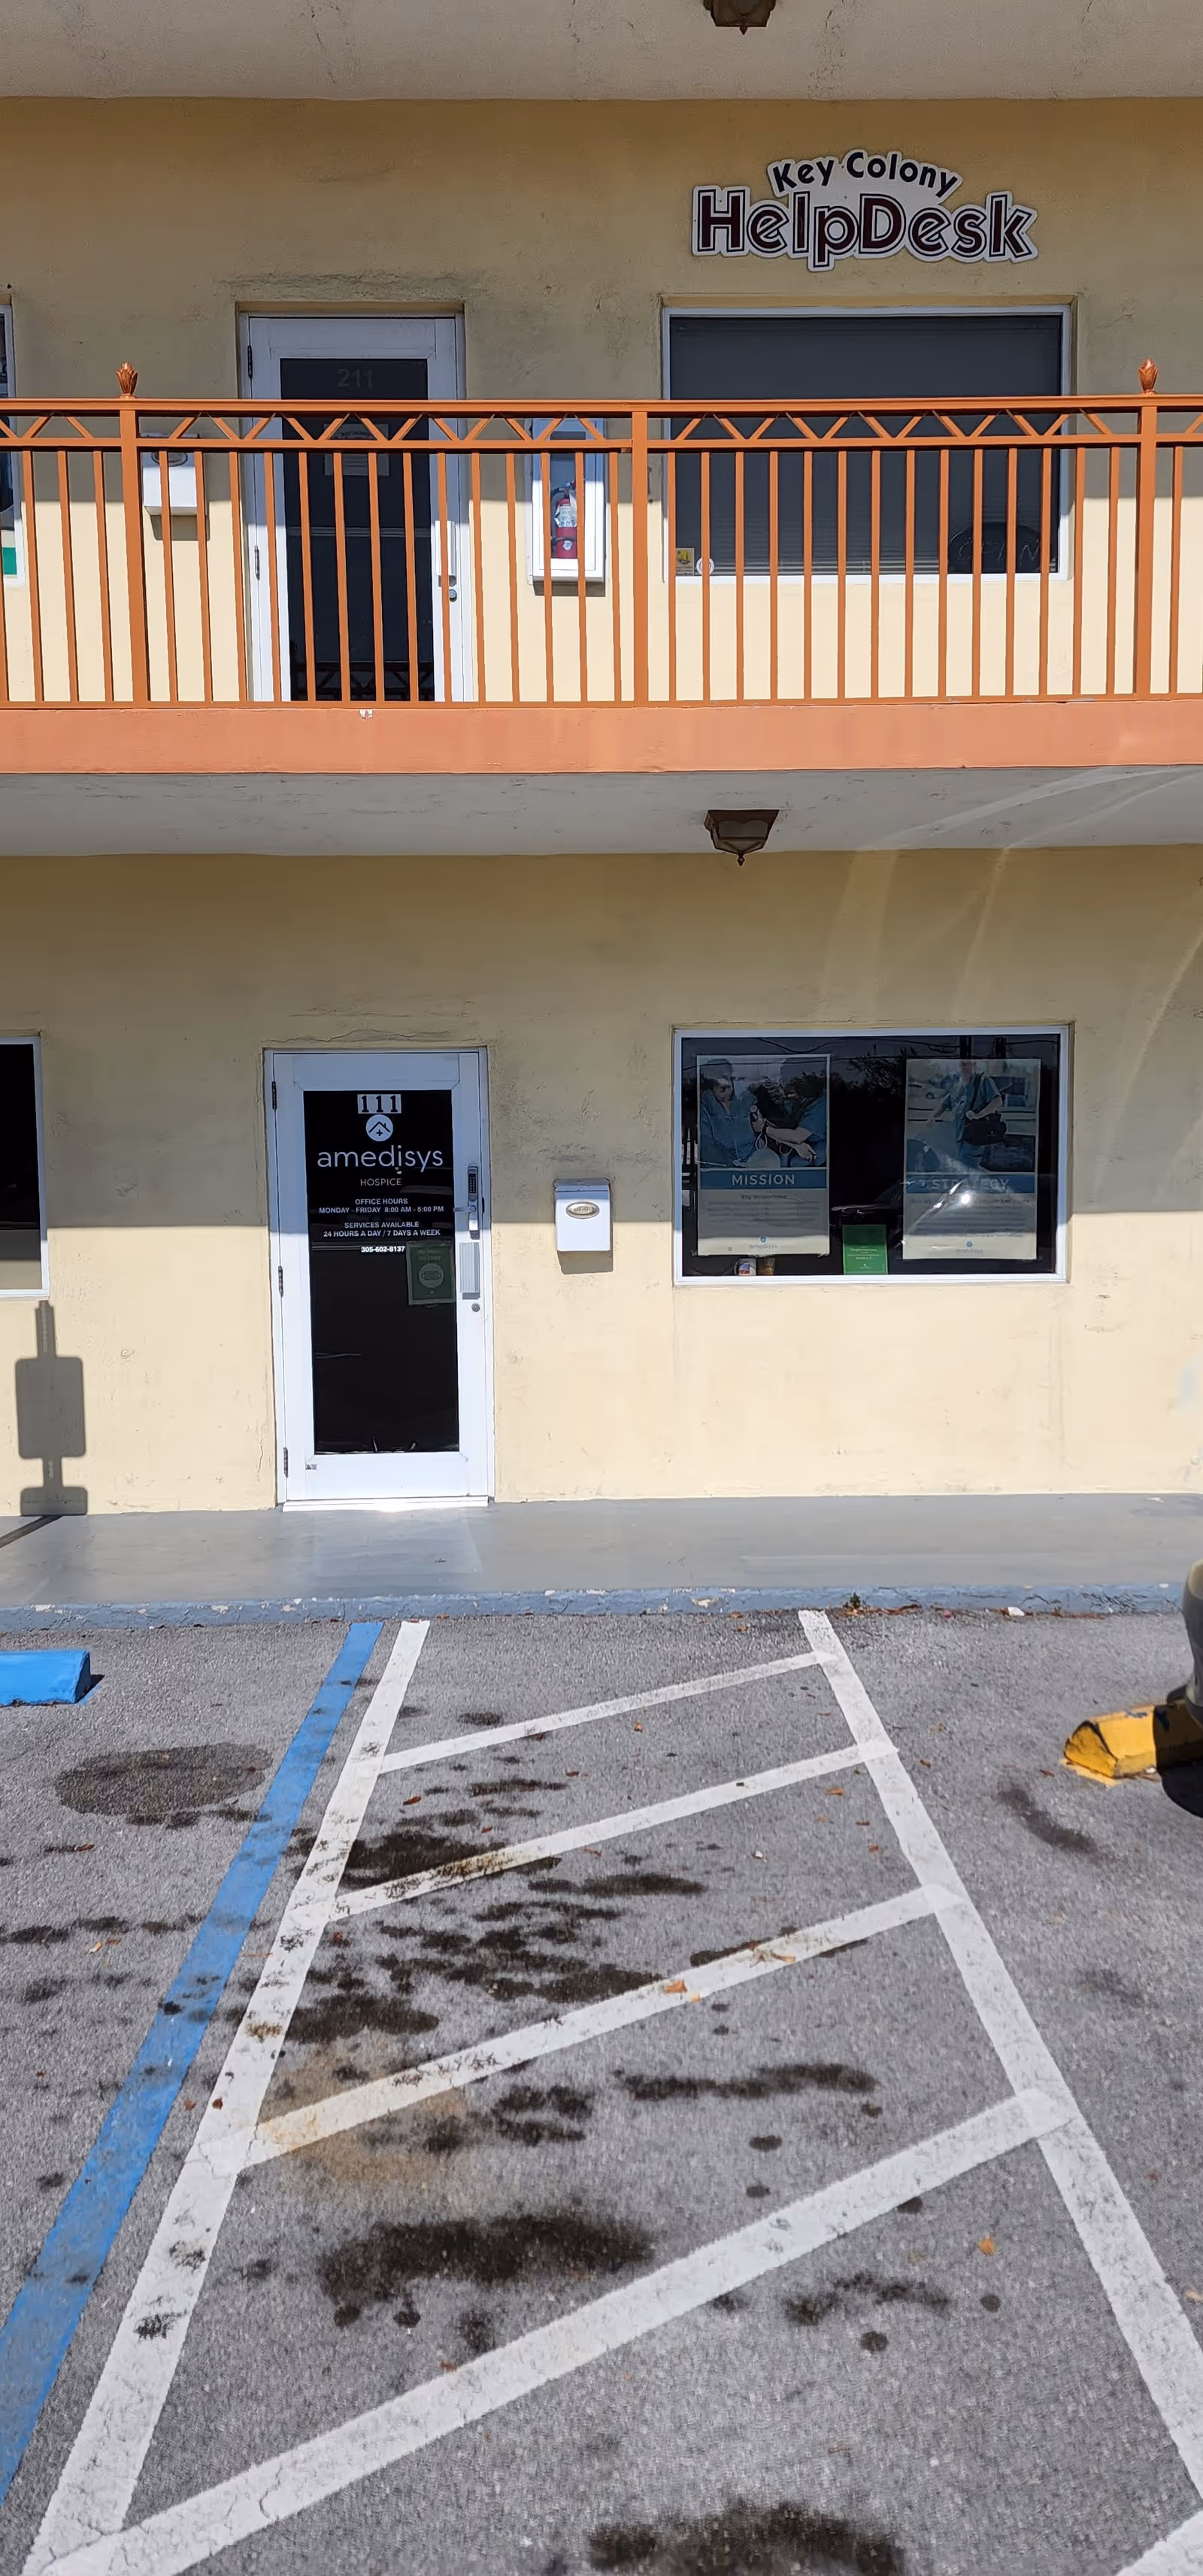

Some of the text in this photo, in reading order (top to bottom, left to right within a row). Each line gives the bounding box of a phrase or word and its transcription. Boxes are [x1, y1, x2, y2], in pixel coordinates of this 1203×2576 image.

[773, 150, 959, 197] Key Colony
[696, 188, 1033, 269] HelpDesk
[338, 368, 373, 388] 211
[360, 1095, 399, 1114] 111
[317, 1144, 444, 1173] amedisys
[360, 1178, 402, 1186] HOSPICE
[732, 1174, 795, 1186] MISSION
